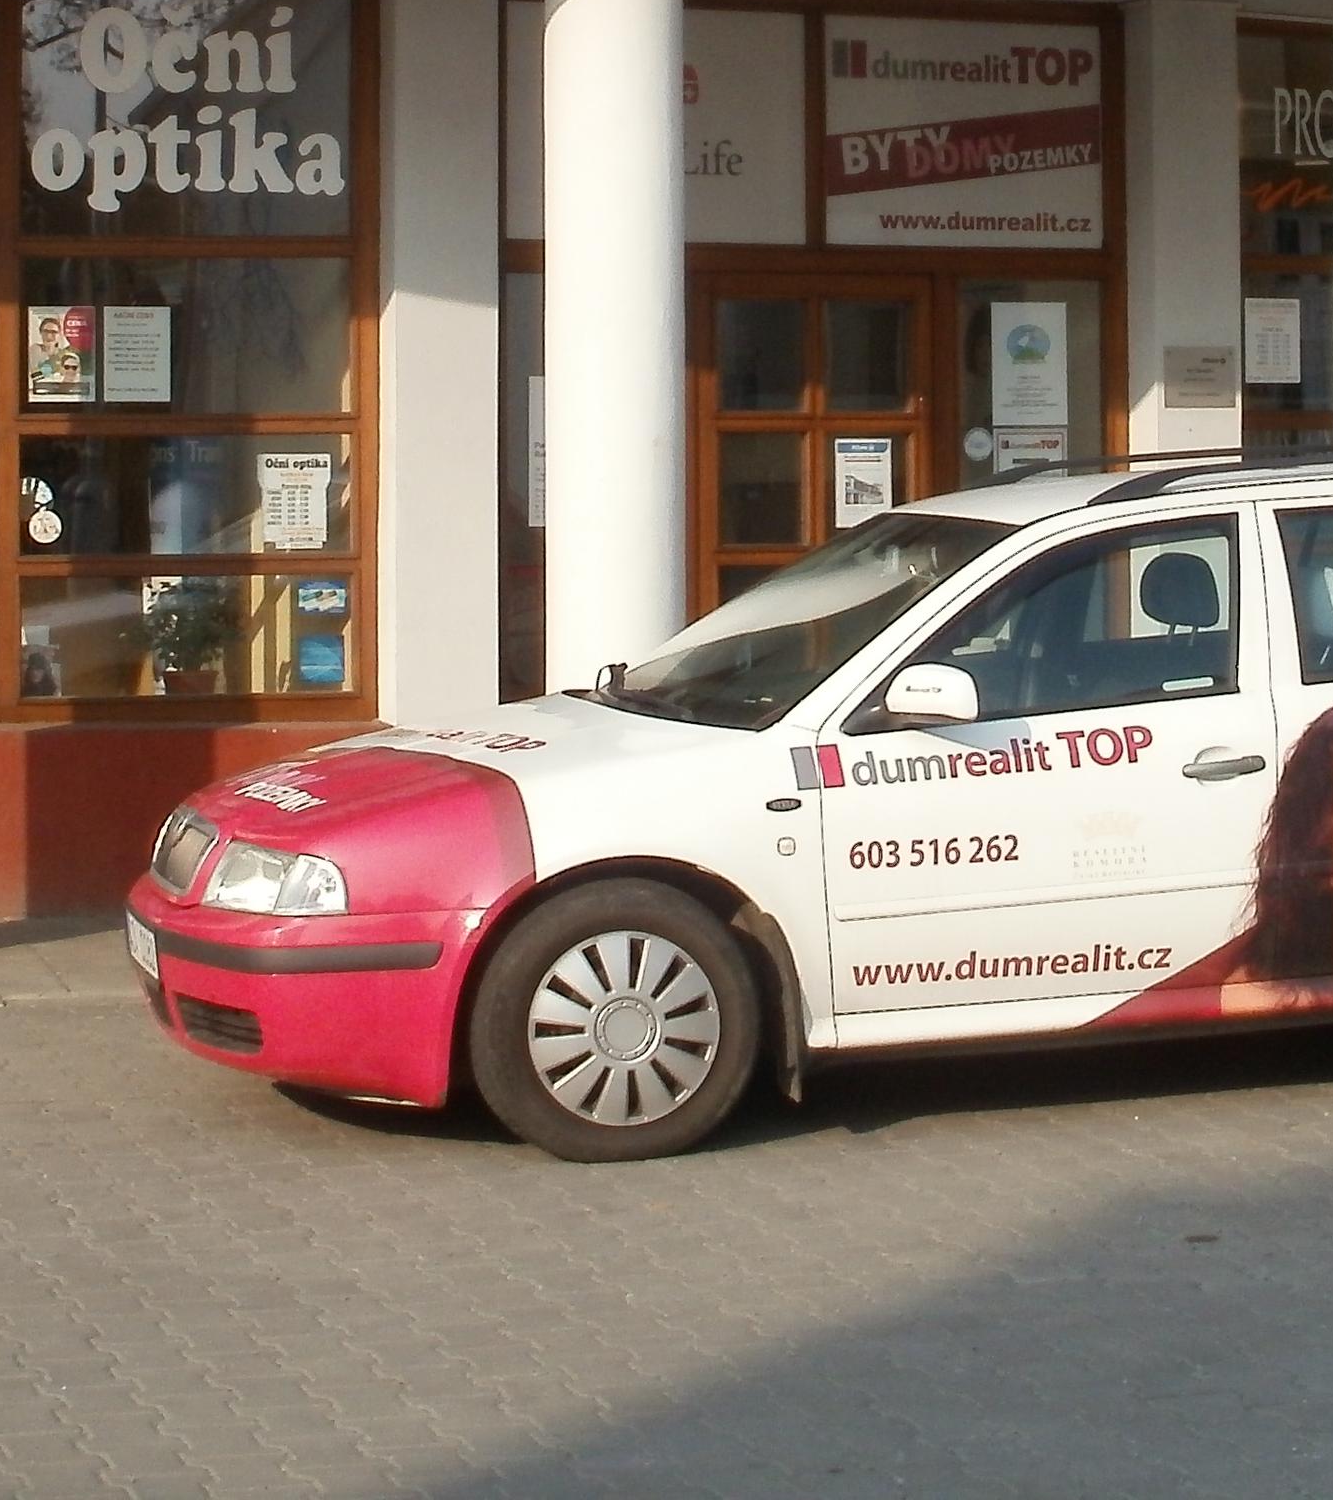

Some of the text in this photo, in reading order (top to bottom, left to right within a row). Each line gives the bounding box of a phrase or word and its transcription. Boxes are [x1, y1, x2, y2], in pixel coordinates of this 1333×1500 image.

[79, 5, 297, 94] Oční
[871, 45, 1094, 87] dumrealitTOP
[30, 104, 346, 213] optika
[840, 125, 955, 177] BYTY
[905, 133, 1017, 181] DOMY
[987, 143, 1093, 177] POZEMKY
[878, 211, 1093, 235] www.dumrealit.cz
[849, 834, 1020, 870] 603 516 262
[852, 943, 1172, 987] www.dumrealit.cz
